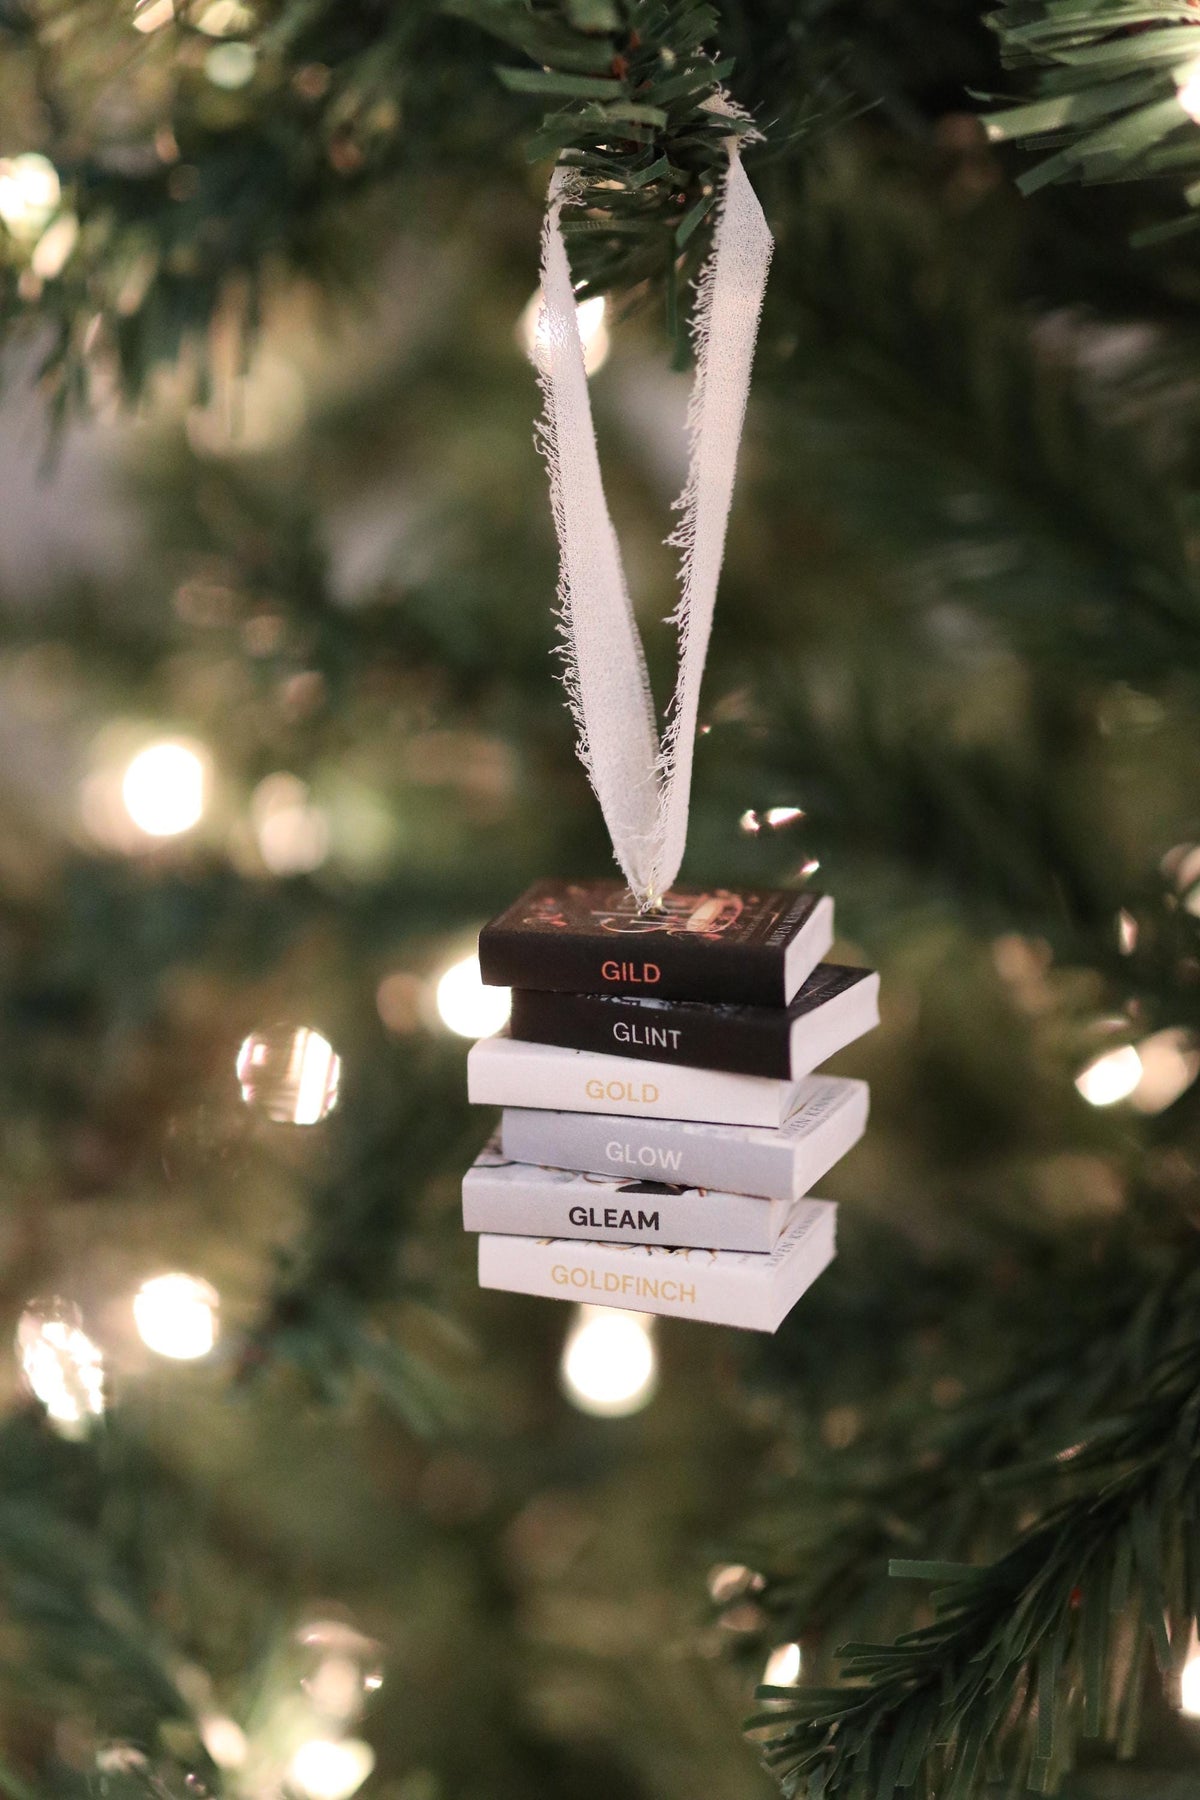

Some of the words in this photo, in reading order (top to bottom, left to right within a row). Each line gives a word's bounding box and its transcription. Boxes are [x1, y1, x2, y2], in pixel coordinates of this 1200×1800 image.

[602, 961, 661, 983] GILD
[613, 1022, 682, 1050] GLINT
[585, 1080, 659, 1104] GOLD
[605, 1141, 683, 1171] GLOW
[569, 1206, 660, 1231] GLEAM
[551, 1264, 697, 1304] GOLDFINCH
